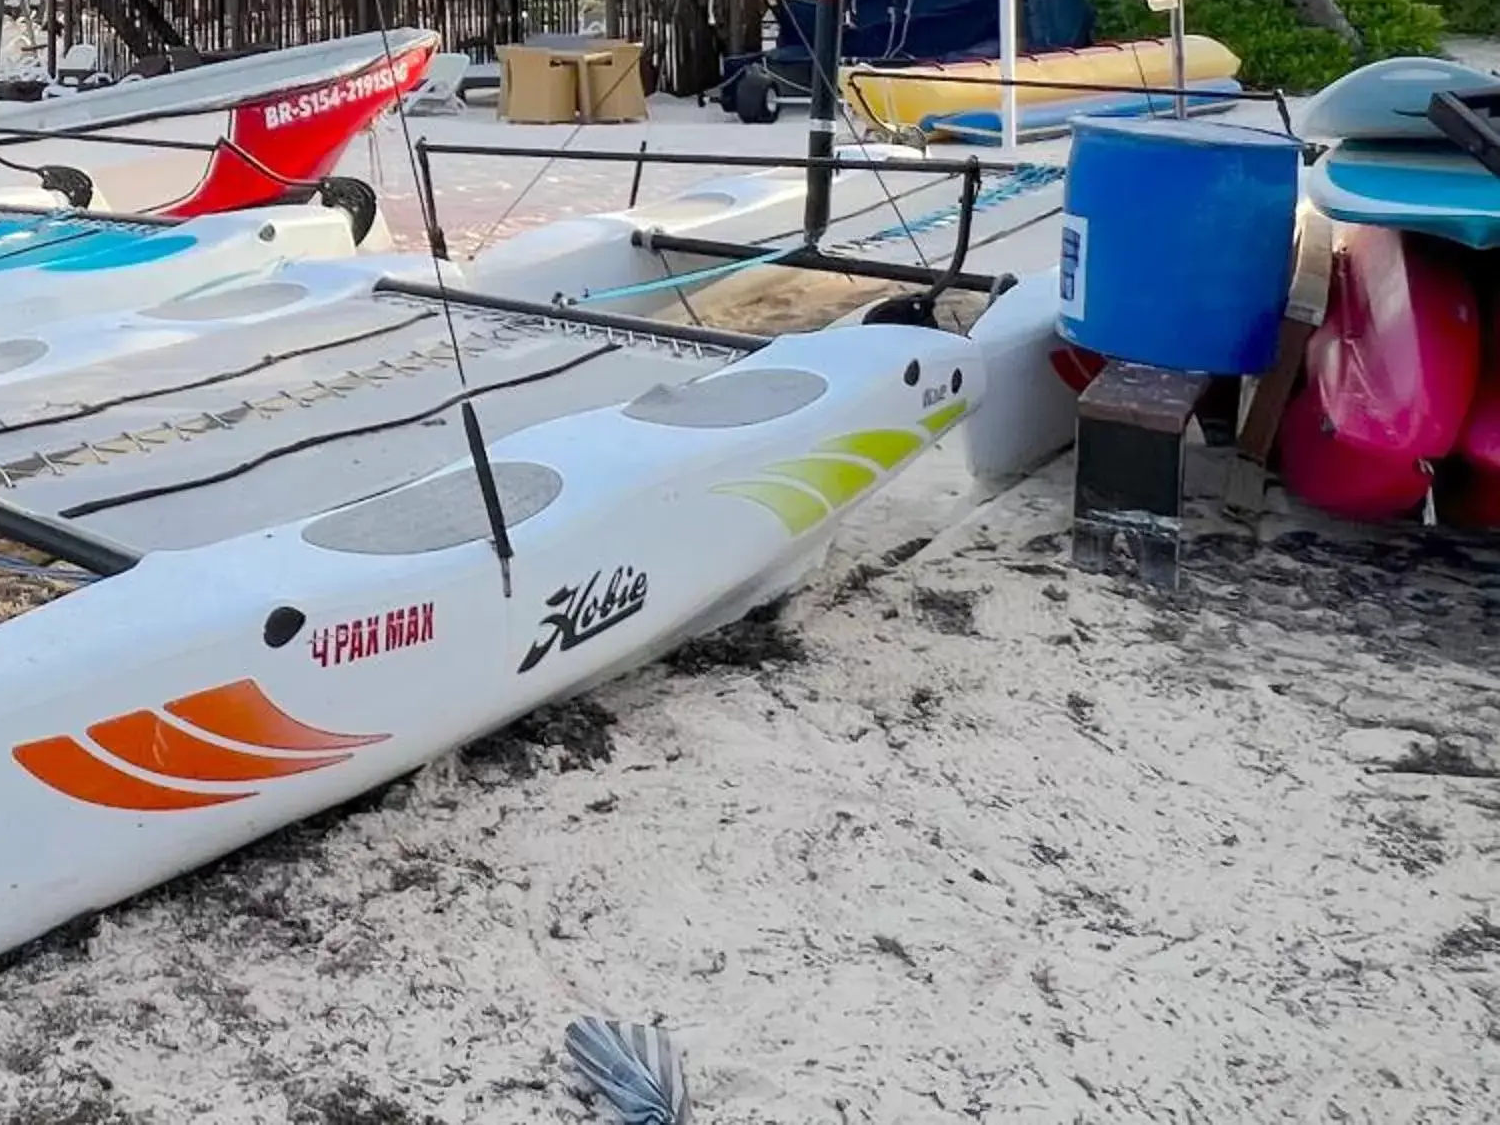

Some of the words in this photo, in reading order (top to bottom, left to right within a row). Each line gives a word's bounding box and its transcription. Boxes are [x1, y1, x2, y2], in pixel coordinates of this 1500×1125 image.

[312, 628, 329, 667] 4
[334, 615, 380, 665] PAX
[384, 601, 435, 652] MAX
[518, 565, 648, 674] Hobie
